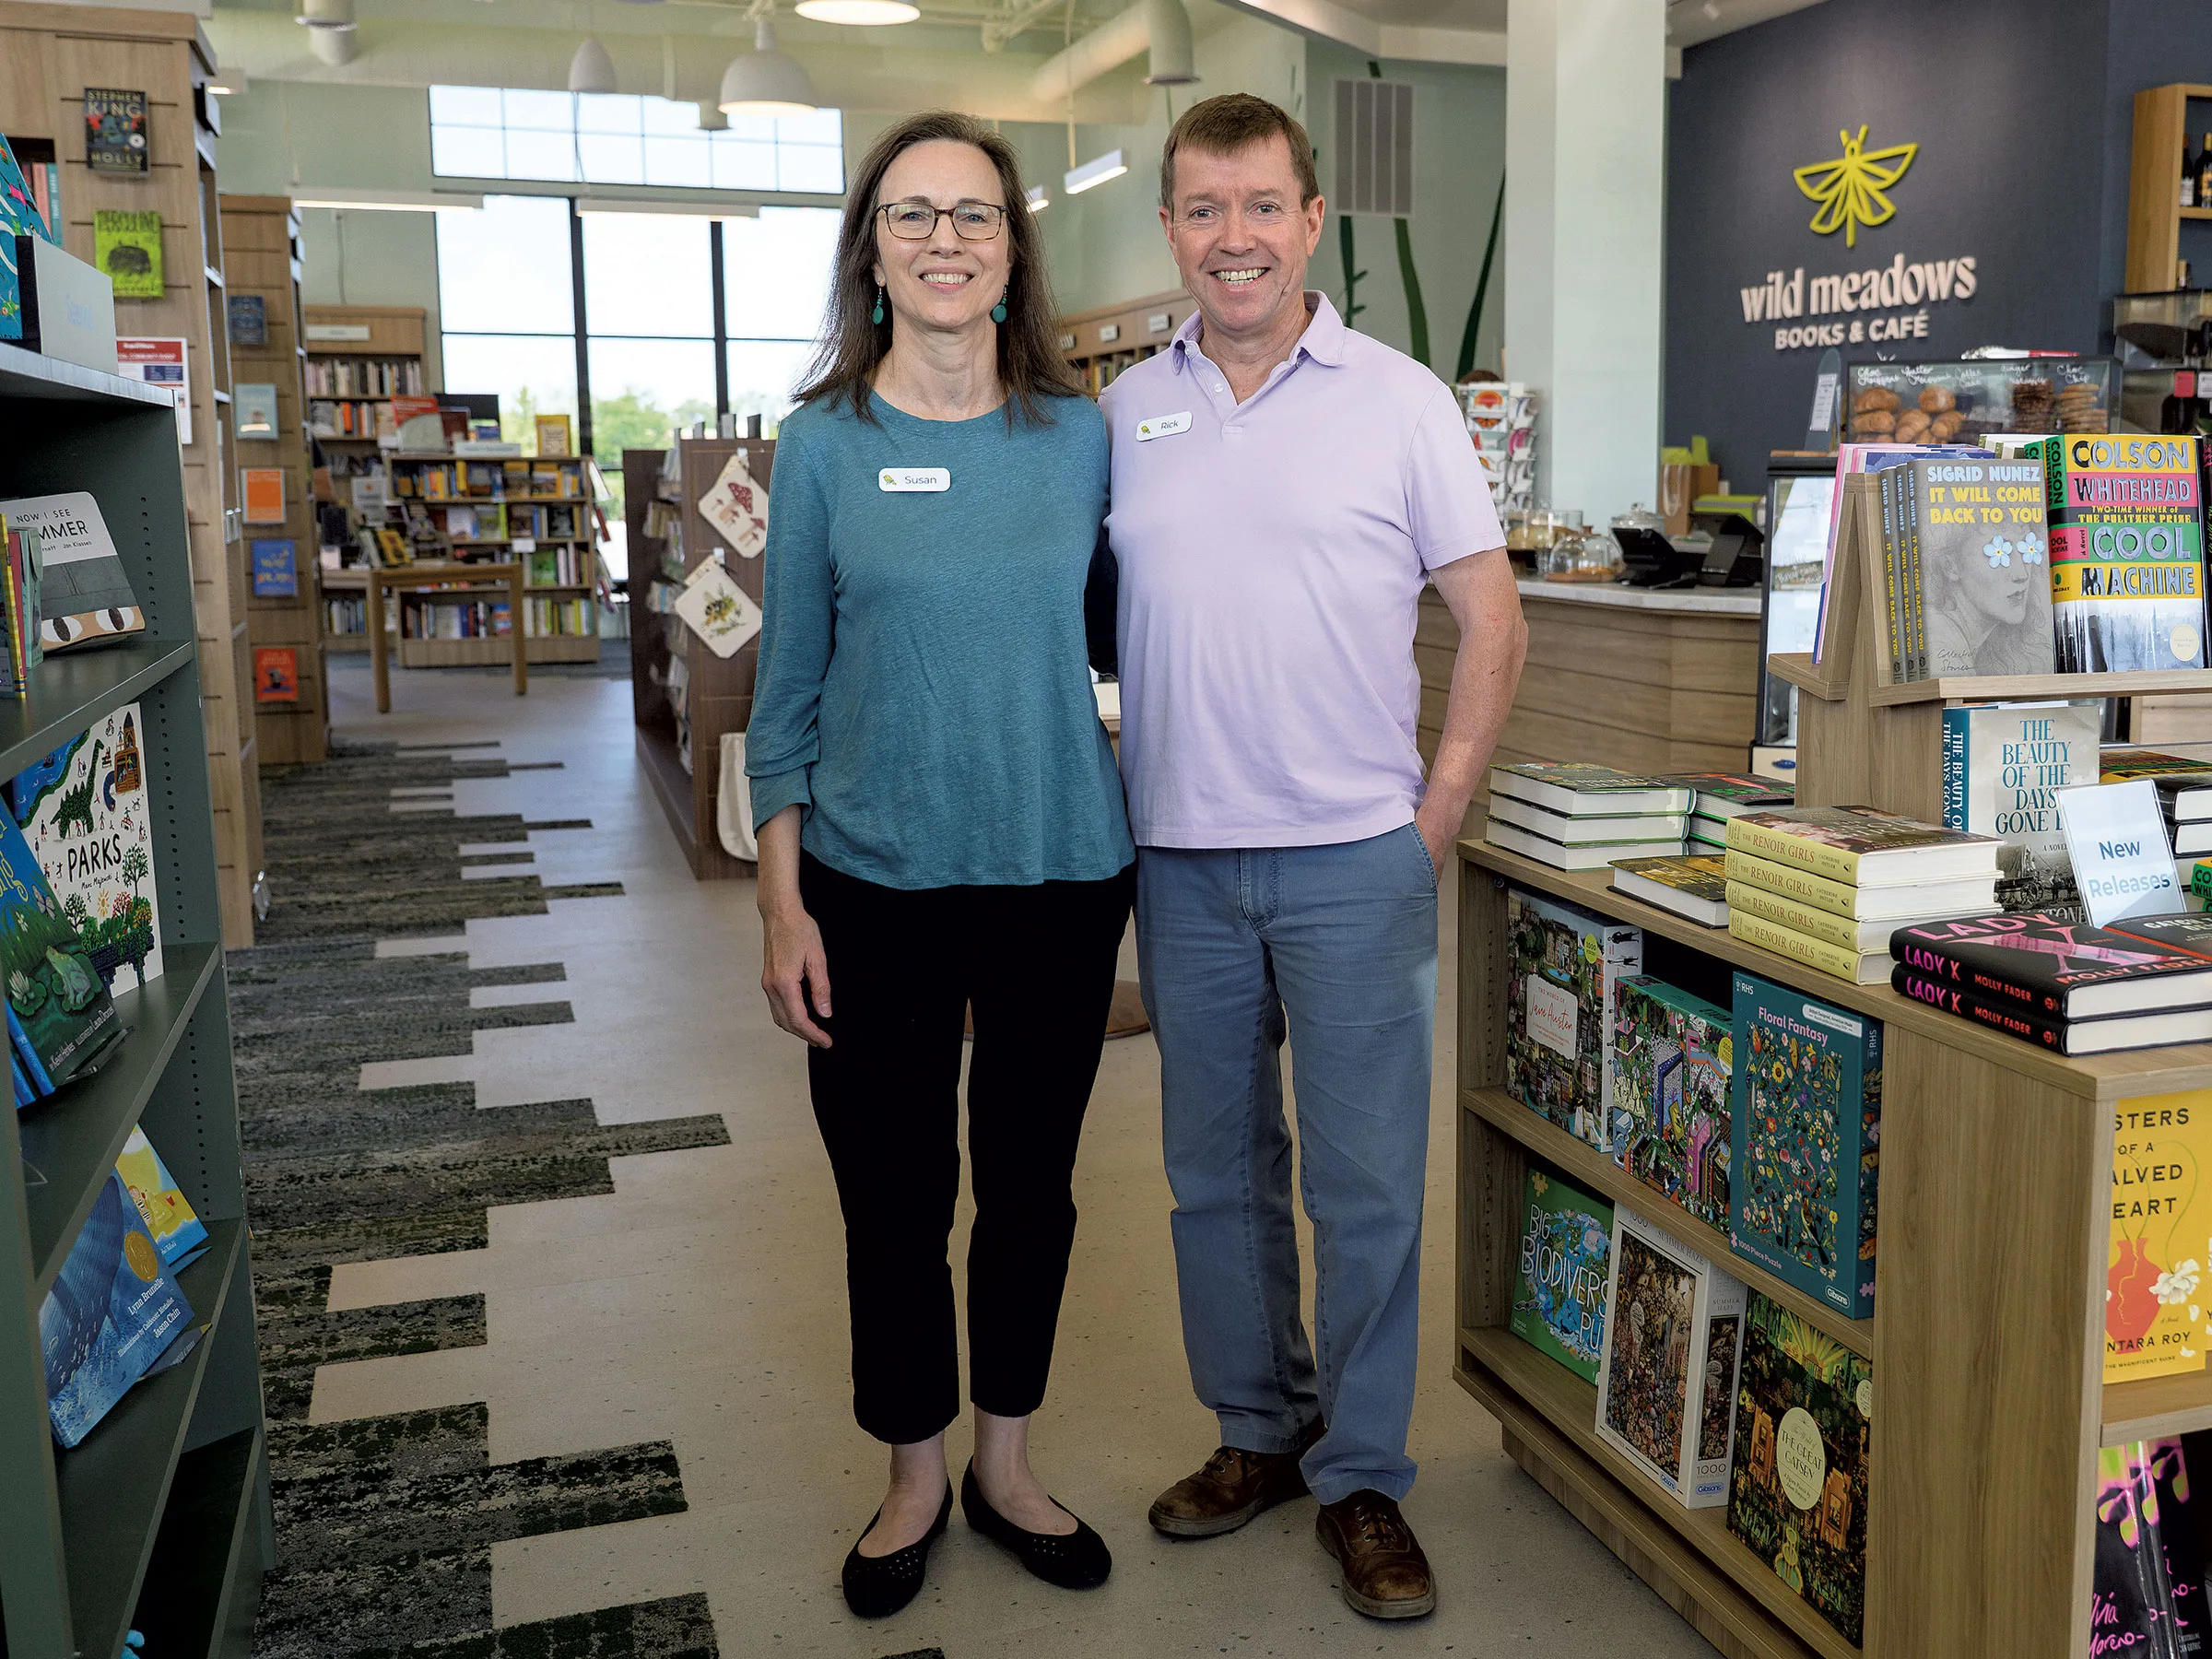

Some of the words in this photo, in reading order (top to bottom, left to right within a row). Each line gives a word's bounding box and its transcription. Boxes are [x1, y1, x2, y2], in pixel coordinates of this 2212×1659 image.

[88, 101, 142, 118] KING
[1740, 267, 1805, 323] wild
[1809, 252, 1977, 315] meadows
[1775, 323, 1843, 350] BOOKS
[1849, 320, 1865, 344] &
[1868, 309, 1929, 342] CAFÉ
[1161, 420, 1179, 429] Rick
[2072, 441, 2189, 468] COLSON
[904, 476, 936, 484] Susan
[1927, 466, 1983, 482] SIGRID
[1989, 466, 2041, 482] NUNEZ
[2052, 441, 2064, 504] COLSON
[1929, 488, 1946, 502] IT
[1950, 488, 1991, 502] WILL
[1995, 487, 2041, 502] COME
[2074, 477, 2191, 502] WHITEHEAD
[17, 513, 40, 524] NOW
[43, 512, 48, 520] I
[53, 509, 71, 518] SEE
[1930, 508, 1975, 524] BACK
[1980, 508, 2000, 524] TO
[2009, 508, 2042, 524] YOU
[2077, 513, 2102, 524] THE
[2104, 513, 2157, 524] PULITZER
[2159, 513, 2192, 523] PRIZE
[2091, 506, 2133, 514] TWO-TIME
[39, 521, 88, 540] MMER
[2092, 525, 2191, 559] COOL
[1886, 543, 1891, 551] IT
[1891, 624, 1897, 635] TO
[2081, 566, 2195, 596] MACHINE
[1905, 621, 1911, 632] TO
[1917, 618, 1923, 629] TO
[1943, 722, 1951, 747] THE
[2019, 719, 2055, 741] THE
[1952, 732, 1963, 758] THE
[2002, 742, 2072, 765] BEAUTY
[1952, 761, 1963, 811] BEAUTY
[2002, 766, 2030, 789] OF
[2035, 764, 2071, 786] THE
[2016, 788, 2056, 810] DAYS
[1995, 811, 2050, 834] GONE
[68, 833, 121, 882] PARKS
[1753, 834, 1785, 854] RENOIR
[1788, 844, 1815, 863] GIRLS
[1818, 853, 1840, 865] CATHERINE
[2099, 841, 2141, 861] New
[1751, 866, 1783, 888] RENOIR
[1786, 877, 1812, 897] GIRLS
[2088, 873, 2171, 899] Releases
[1753, 898, 1785, 919] RENOIR
[1788, 911, 1814, 929] GIRLS
[1907, 913, 2060, 941] LADY
[1755, 926, 1786, 948] RENOIR
[1789, 940, 1815, 959] GIRLS
[1904, 945, 1945, 974] LADY
[1950, 959, 1960, 981] X
[1974, 973, 2002, 993] MOLLY
[2005, 983, 2031, 1003] FADER
[2055, 967, 2133, 984] MOLLY
[2138, 958, 2211, 973] FADER
[1741, 982, 1754, 995] RHS
[1530, 994, 1547, 1018] Jane
[1547, 1002, 1573, 1031] Austen
[1906, 977, 1946, 1006] LADY
[1950, 991, 1962, 1014] X
[1974, 1006, 2002, 1025] MOLLY
[2004, 1017, 2030, 1036] FADER
[1758, 1006, 1786, 1029] Floral
[1788, 1018, 1828, 1048] Fantasy
[1869, 1029, 1877, 1049] RHS
[2115, 1107, 2190, 1132] STERS
[2118, 1144, 2138, 1155] OF
[2146, 1142, 2154, 1152] A
[2112, 1164, 2183, 1185] ALVED
[2112, 1197, 2177, 1219] EART
[1530, 1204, 1551, 1240] BIG
[1658, 1230, 1687, 1254] SUMMER
[1686, 1246, 1704, 1265] HAZE
[1738, 1240, 1750, 1253] 1000
[1764, 1253, 1783, 1270] Puzzle
[1521, 1235, 1608, 1318] BIODIVERS
[127, 1298, 144, 1316] Lynn
[141, 1277, 165, 1302] Brunelle
[1827, 1288, 1848, 1306] Gibsons
[152, 1321, 169, 1338] Jason
[167, 1307, 182, 1324] Chin
[2107, 1336, 2155, 1352] NTARA
[2161, 1331, 2191, 1345] ROY
[1781, 1430, 1795, 1450] THE
[1797, 1442, 1823, 1470] GREAT
[1697, 1464, 1726, 1475] 1000
[1785, 1451, 1814, 1480] GATSBY
